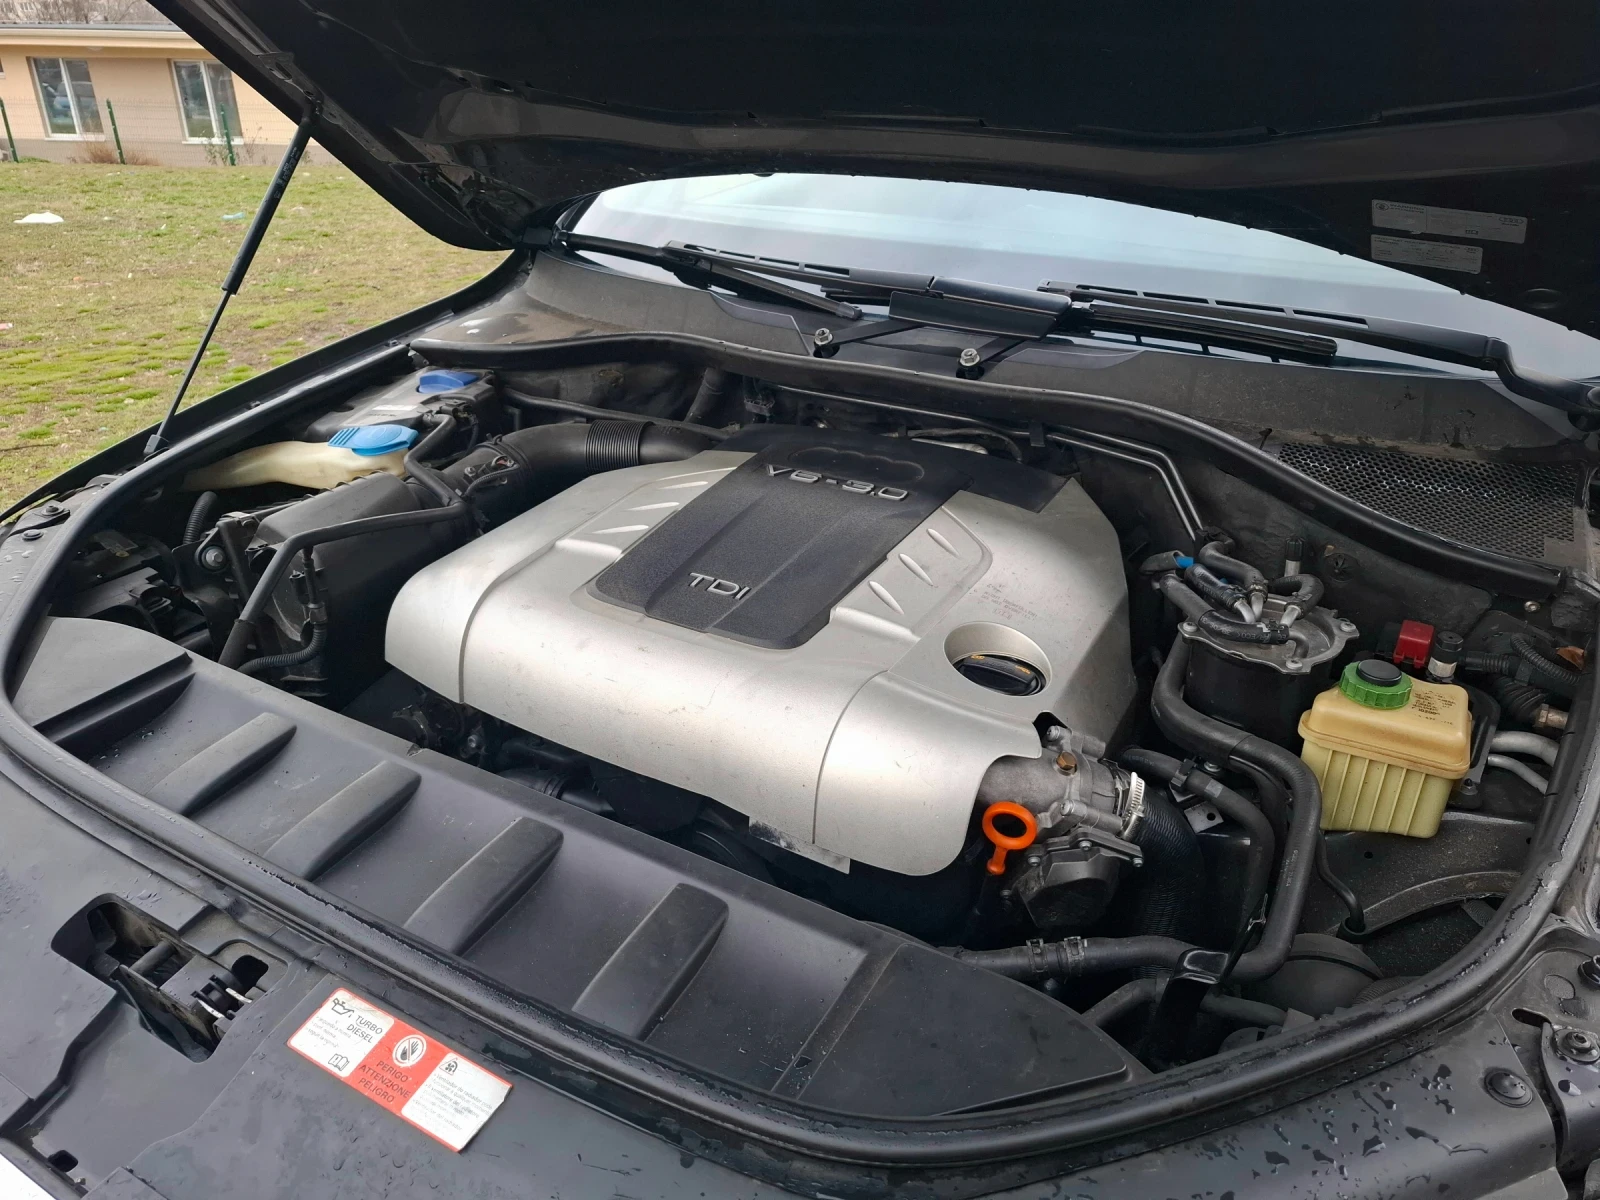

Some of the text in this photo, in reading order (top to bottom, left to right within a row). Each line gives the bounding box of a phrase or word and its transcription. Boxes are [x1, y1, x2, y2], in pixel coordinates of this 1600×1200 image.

[689, 572, 751, 600] TDI
[347, 1024, 373, 1043] DIESEL
[356, 1015, 383, 1035] TURBO
[359, 1064, 411, 1099] ATTENZIONE
[376, 1060, 409, 1083] PERIGO
[358, 1077, 395, 1103] PELIGRO
